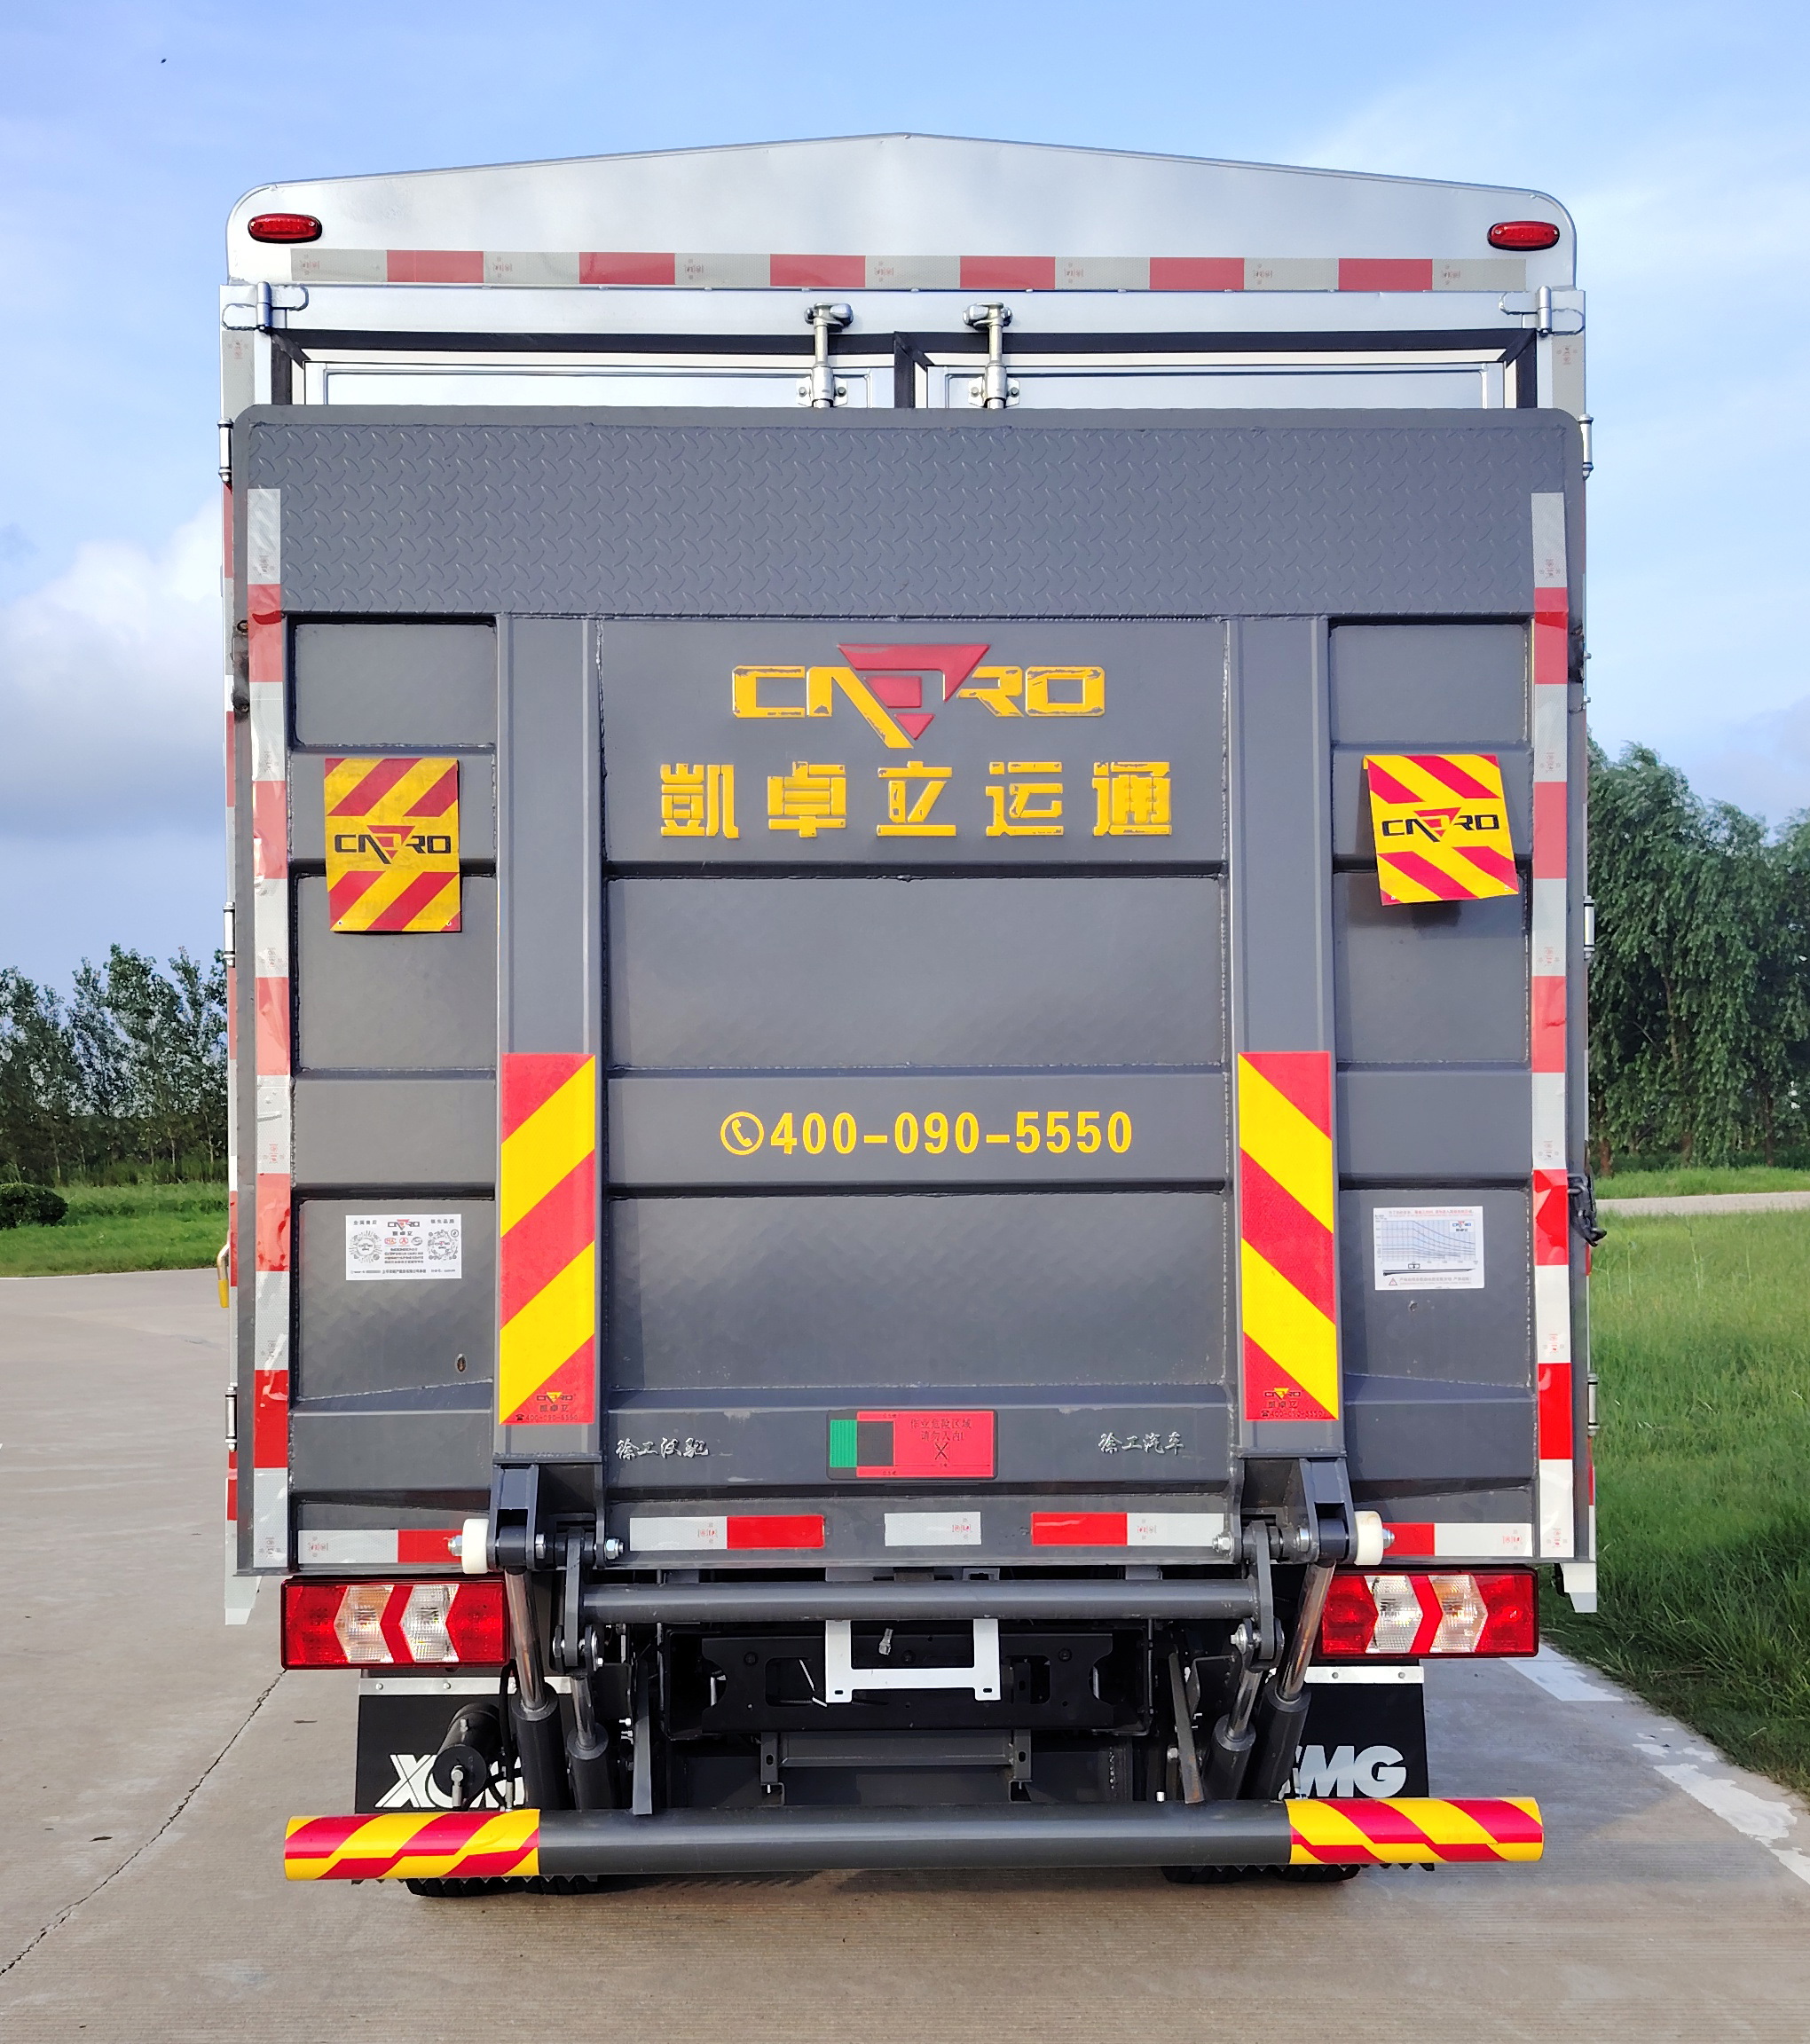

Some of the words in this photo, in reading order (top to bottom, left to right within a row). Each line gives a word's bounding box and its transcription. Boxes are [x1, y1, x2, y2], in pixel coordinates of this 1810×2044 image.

[660, 760, 1172, 839] 凱卓立运通
[769, 1111, 1132, 1155] 400-090-5550
[1098, 1432, 1184, 1455] 徐工汽车
